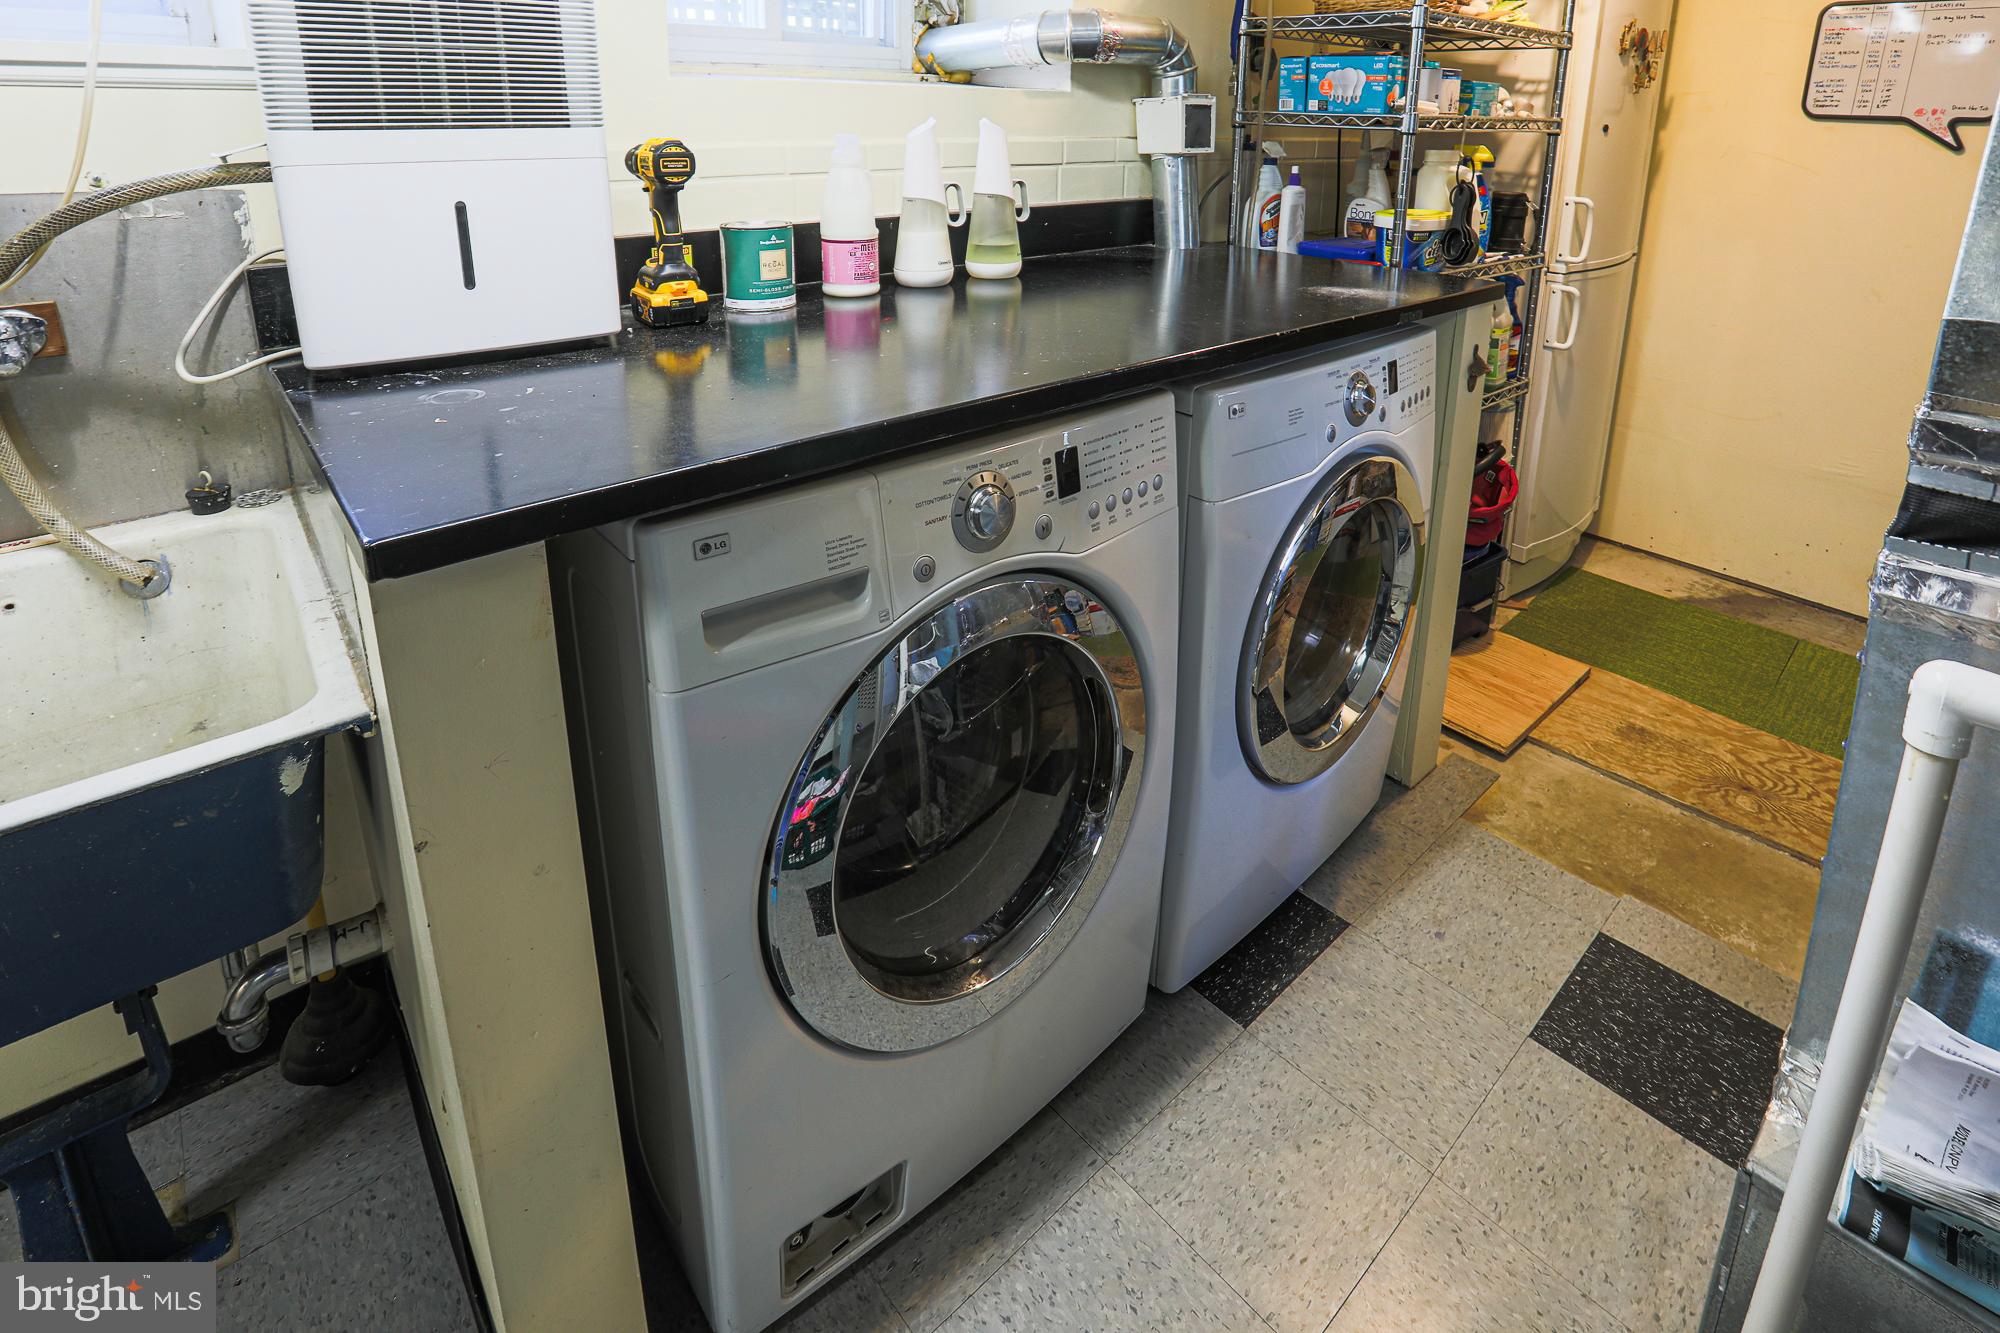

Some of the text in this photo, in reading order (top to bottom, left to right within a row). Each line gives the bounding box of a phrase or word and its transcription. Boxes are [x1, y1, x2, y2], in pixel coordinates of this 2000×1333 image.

[998, 459, 1019, 470] DELICATES
[943, 477, 962, 486] NORMAL
[924, 515, 948, 526] SANITARY
[714, 540, 727, 551] LG
